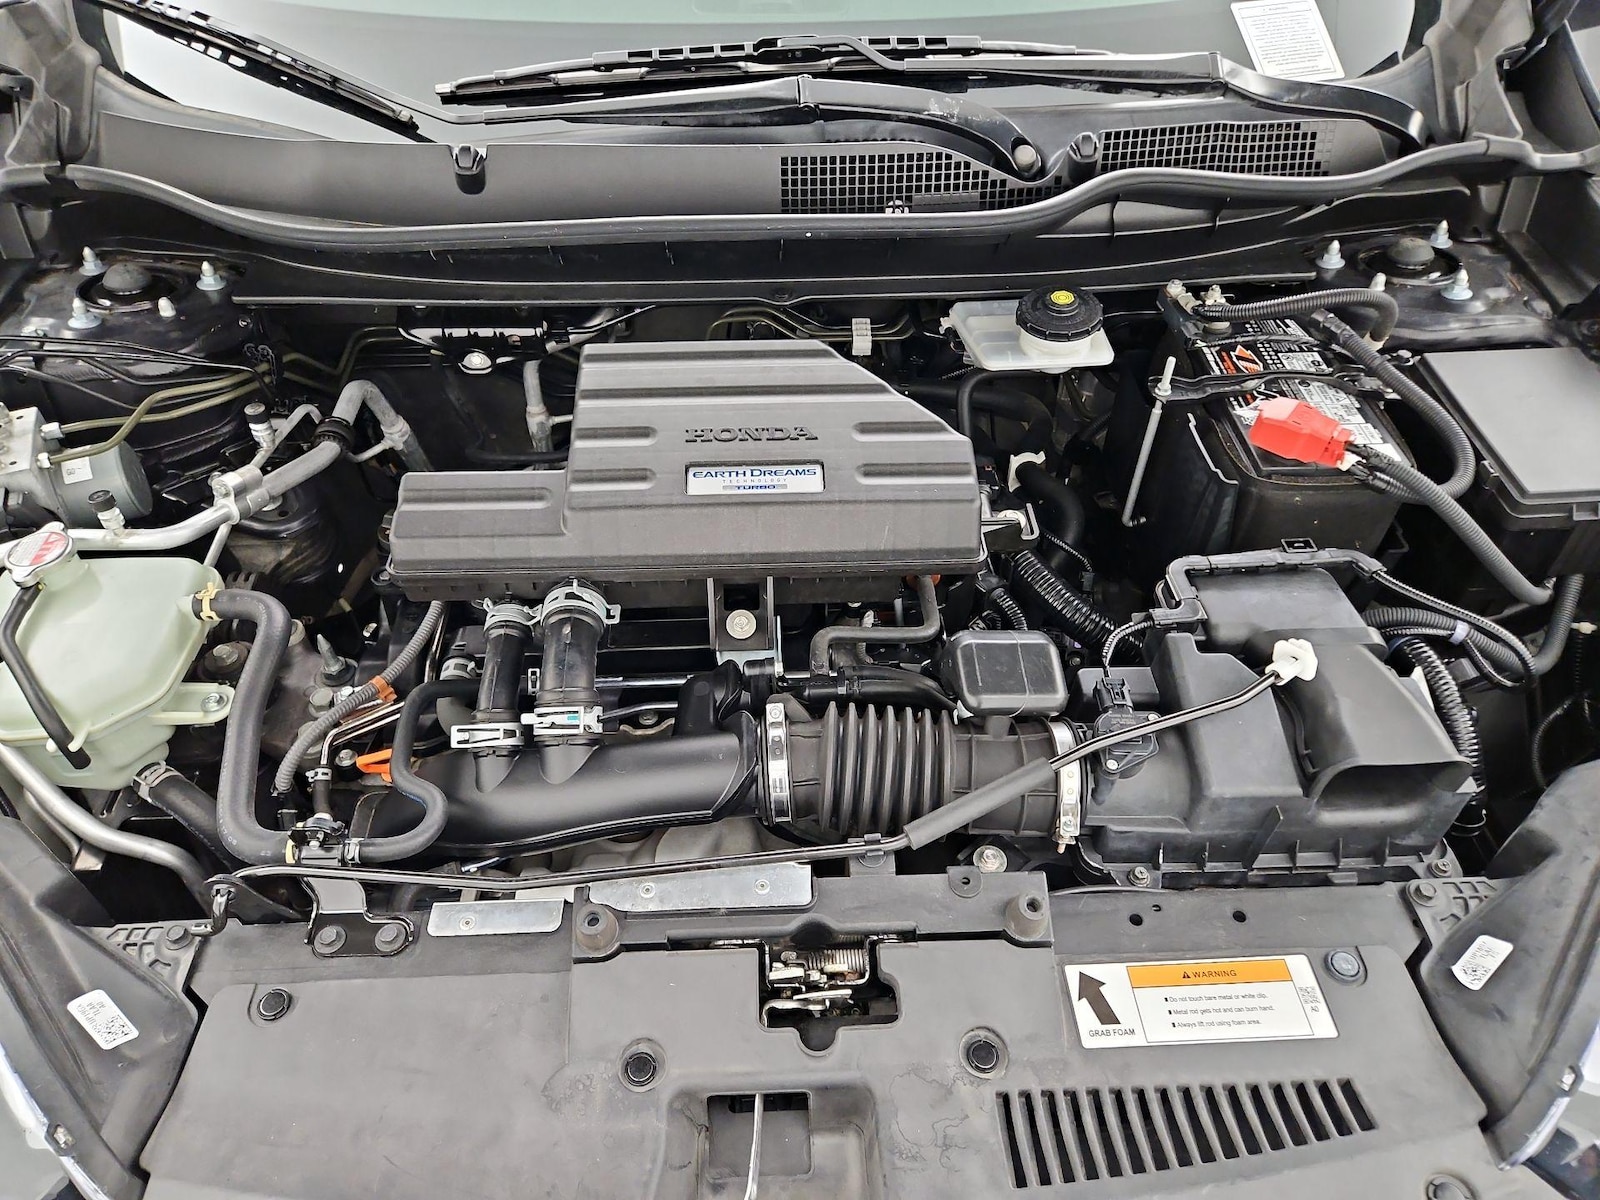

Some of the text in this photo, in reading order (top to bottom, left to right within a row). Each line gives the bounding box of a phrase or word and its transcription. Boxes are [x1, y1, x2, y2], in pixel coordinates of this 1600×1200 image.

[685, 426, 819, 443] HONDA
[692, 468, 817, 478] EARTH DREAMS
[1192, 969, 1237, 979] WARNING
[1199, 1008, 1212, 1016] gets
[1088, 1028, 1136, 1038] GRAB FOAM
